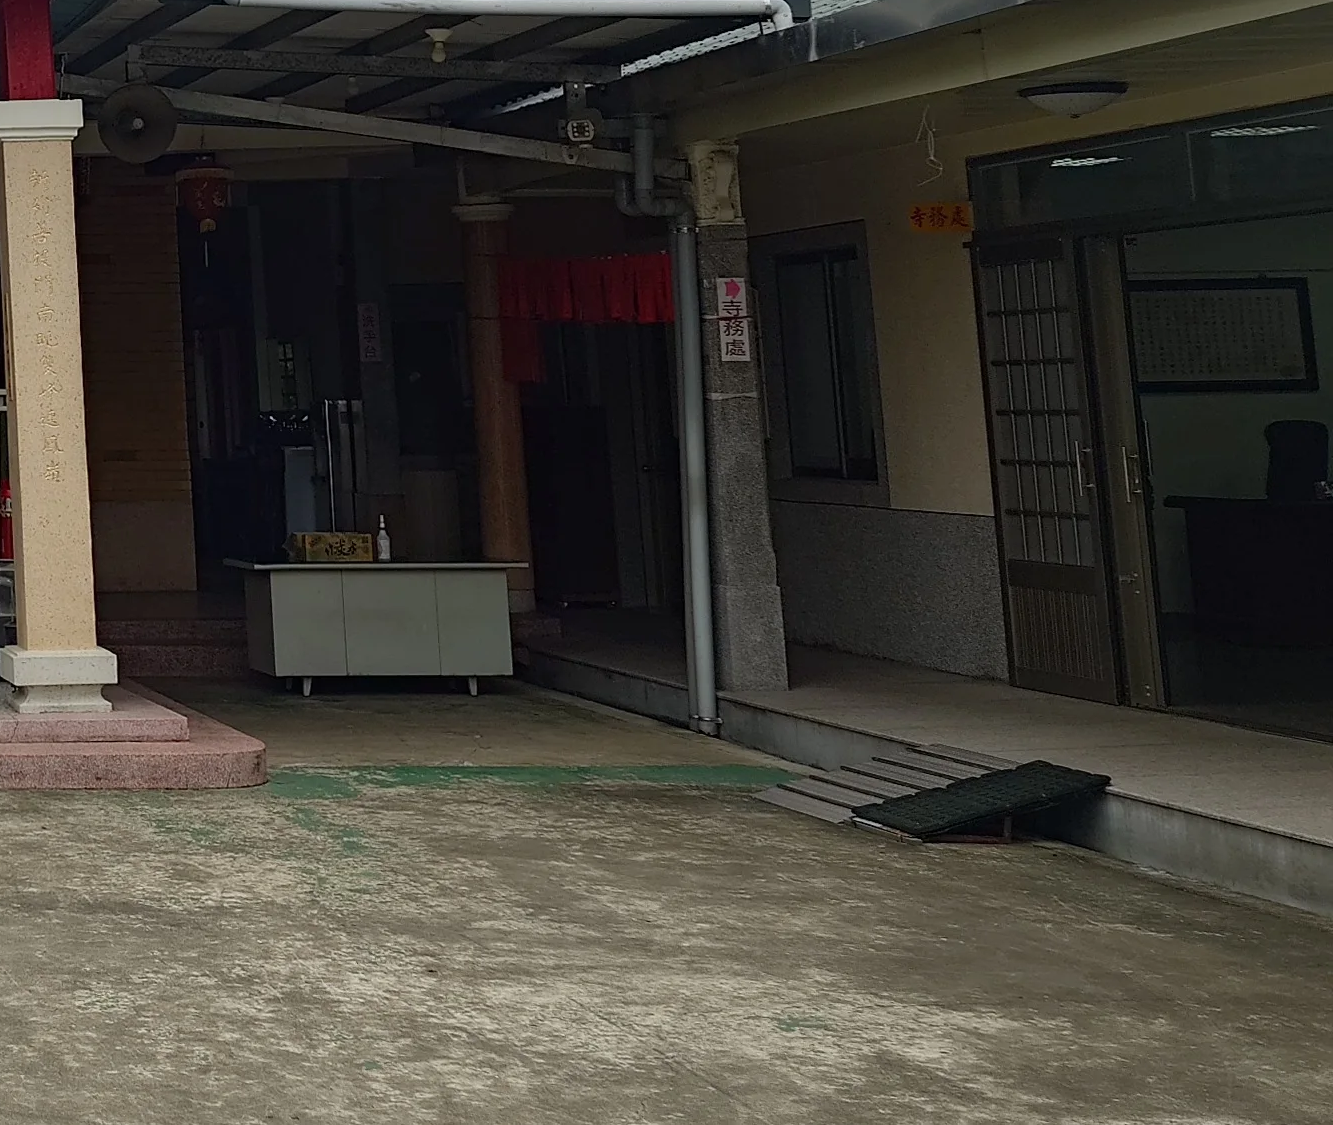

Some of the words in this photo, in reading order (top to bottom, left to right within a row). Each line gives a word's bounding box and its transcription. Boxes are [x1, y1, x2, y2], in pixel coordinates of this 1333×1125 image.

[910, 206, 969, 227] 寺務處
[722, 300, 746, 356] 寺務處
